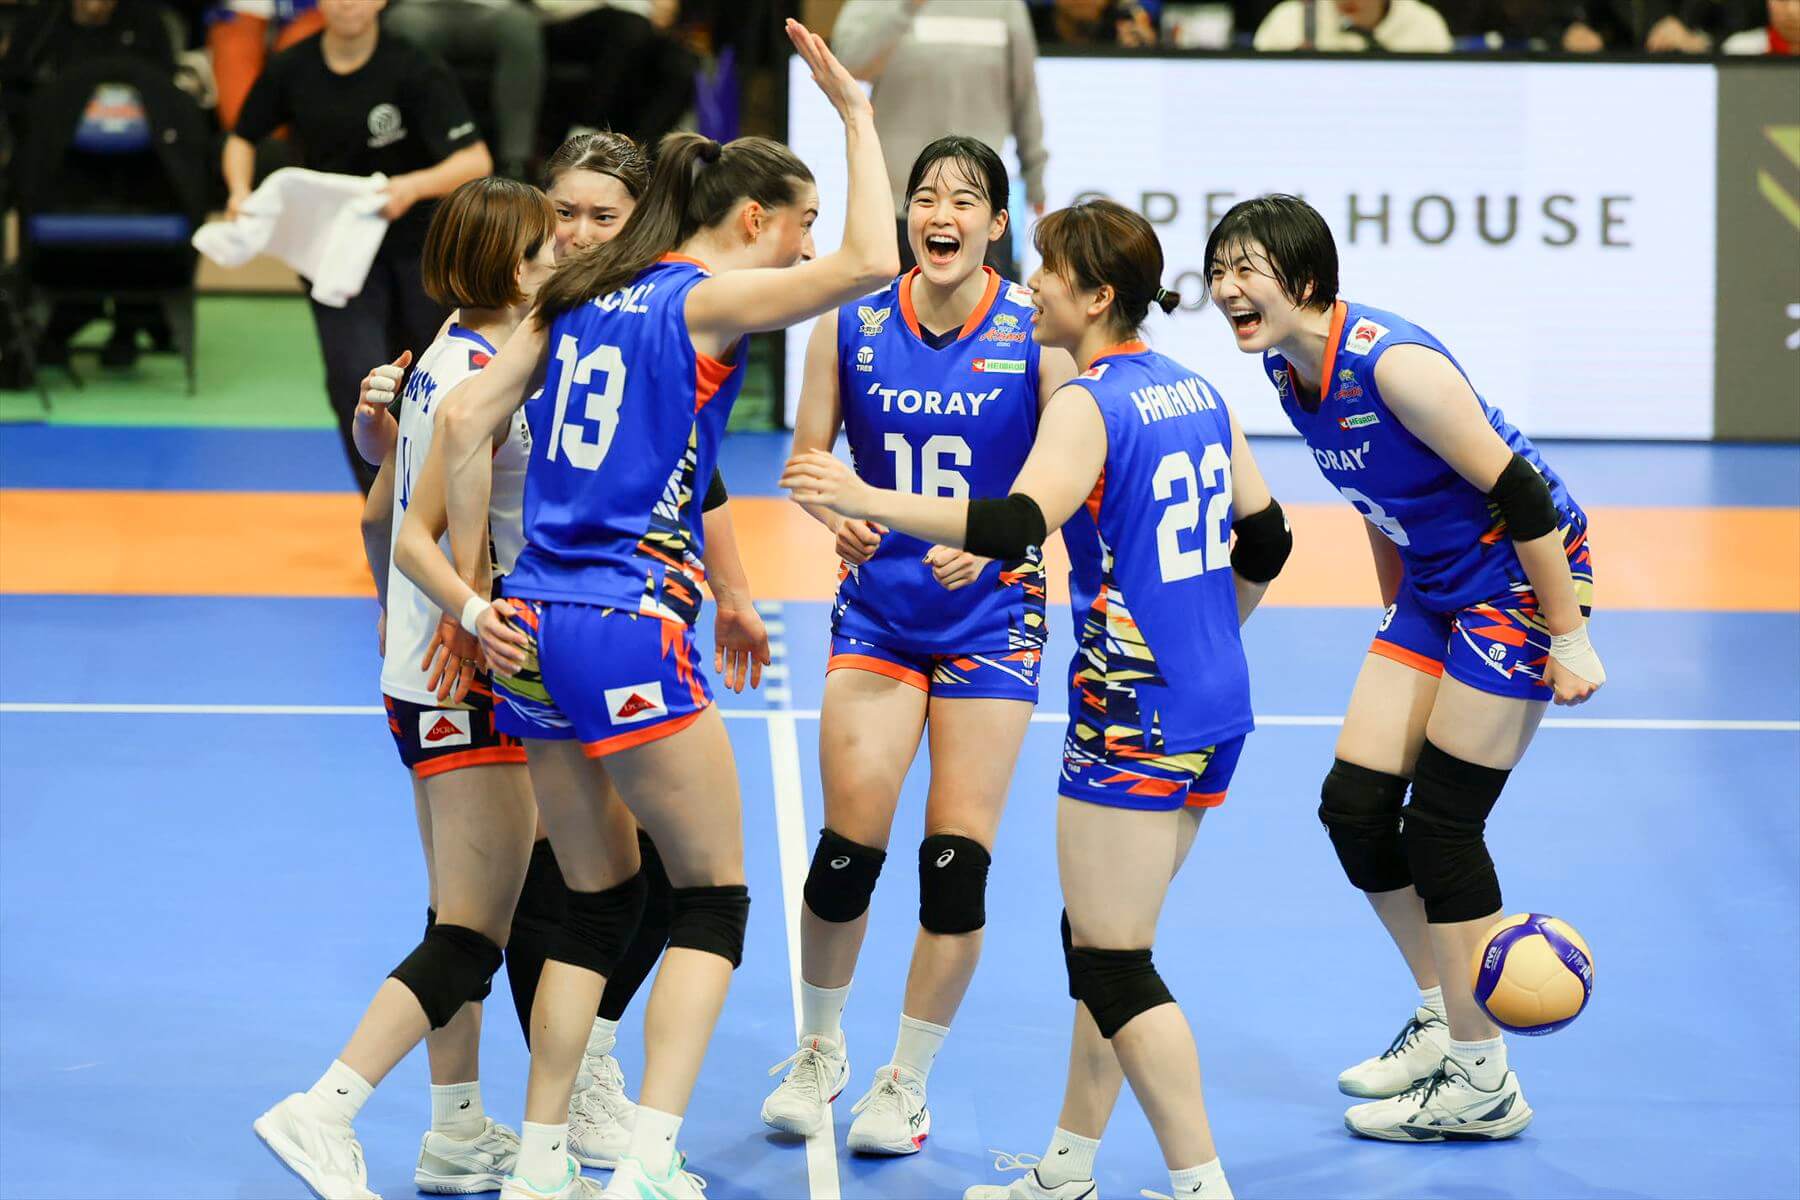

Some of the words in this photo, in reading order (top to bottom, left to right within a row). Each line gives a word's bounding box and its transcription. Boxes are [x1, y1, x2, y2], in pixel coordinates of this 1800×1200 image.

[1346, 193, 1633, 246] HOUSE
[546, 333, 627, 471] 13
[884, 432, 972, 500] 16
[1152, 442, 1232, 583] 22
